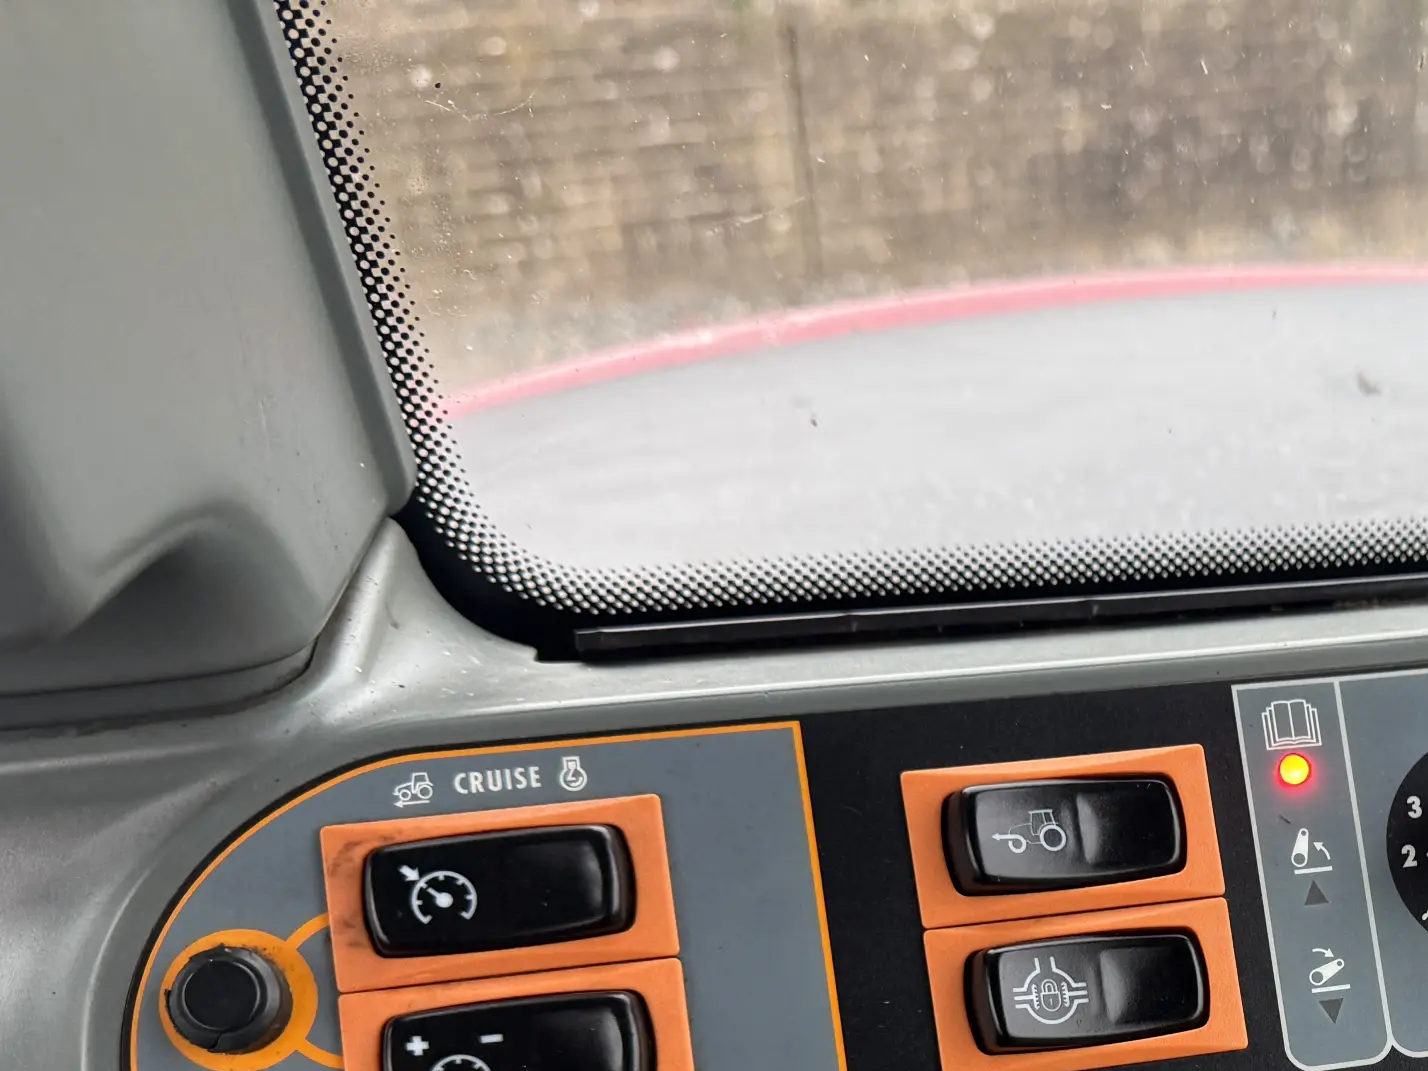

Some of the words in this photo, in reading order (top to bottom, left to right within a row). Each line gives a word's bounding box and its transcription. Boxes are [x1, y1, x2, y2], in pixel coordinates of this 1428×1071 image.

[454, 767, 542, 795] CRUISE
[1407, 796, 1422, 818] 3
[1401, 845, 1417, 867] 2
